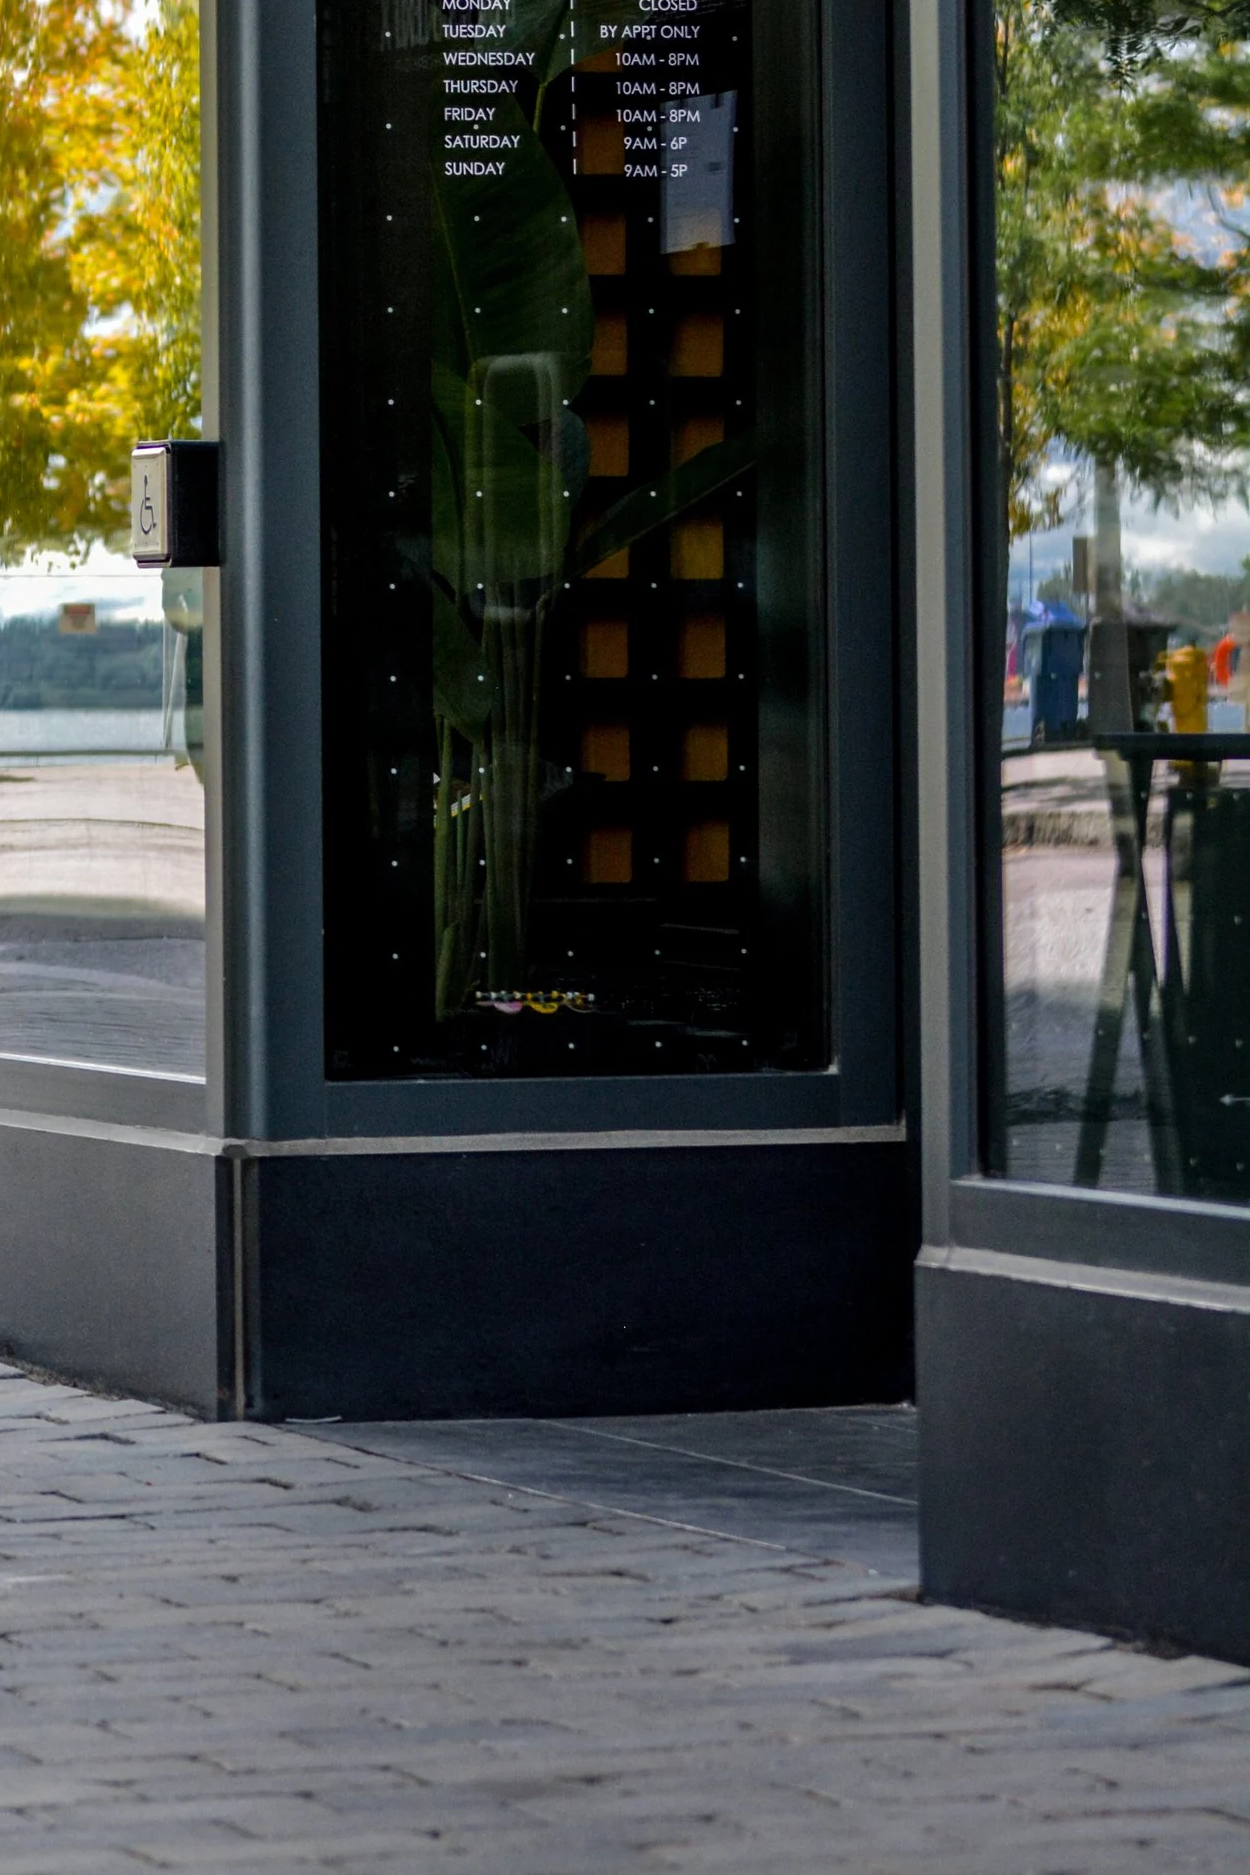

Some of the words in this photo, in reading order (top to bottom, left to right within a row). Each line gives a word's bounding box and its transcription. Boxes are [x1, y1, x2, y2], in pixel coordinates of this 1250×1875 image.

[442, 24, 506, 38] TUESDAY
[599, 25, 618, 39] BY
[659, 25, 700, 39] ONLY
[442, 52, 535, 66] WEDNESDAY
[615, 52, 657, 66] 10AM
[668, 52, 699, 66] 8PM
[443, 79, 518, 94] THURSDAY
[615, 81, 657, 95] 10AM
[668, 81, 700, 95] 8PM
[444, 107, 495, 121] FRIDAY
[615, 109, 658, 123] 10AM
[669, 109, 701, 123] 8PM
[444, 135, 520, 149] SATURDAY
[623, 136, 658, 150] 9AM
[670, 136, 688, 150] 6P
[444, 161, 505, 176] SUNDAY
[623, 163, 658, 178] 9AM
[670, 163, 688, 178] 5P
